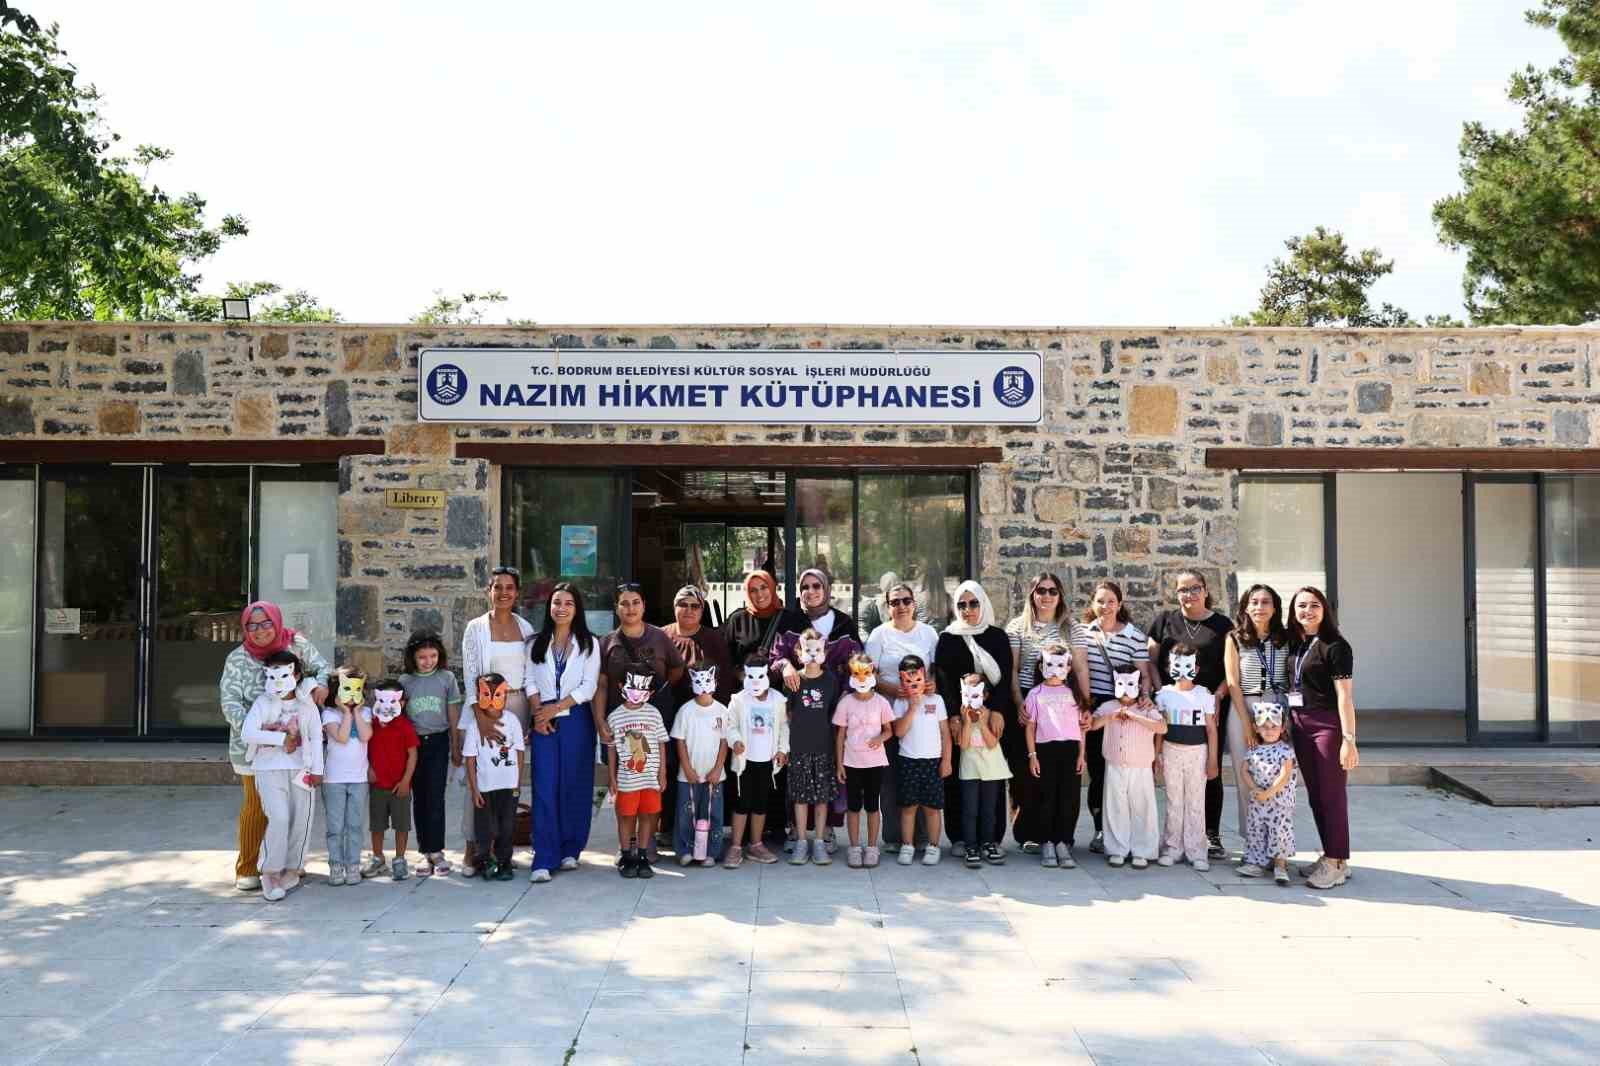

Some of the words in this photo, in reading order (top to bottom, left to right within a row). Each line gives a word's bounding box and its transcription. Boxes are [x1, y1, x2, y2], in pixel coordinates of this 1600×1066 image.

[531, 366, 553, 376] T.C.
[557, 366, 612, 376] BODRUM
[616, 364, 691, 376] BELEDİYESİ
[694, 365, 745, 376] KÜLTÜR
[749, 367, 798, 376] SOSYAL
[805, 365, 846, 378] İŞLERİ
[850, 365, 931, 377] MÜDÜRLÜĞÜ
[479, 383, 586, 407] NAZIM
[599, 379, 729, 407] HİKMET
[740, 380, 981, 408] KÜTÜPHANESİ
[392, 491, 439, 506] Library
